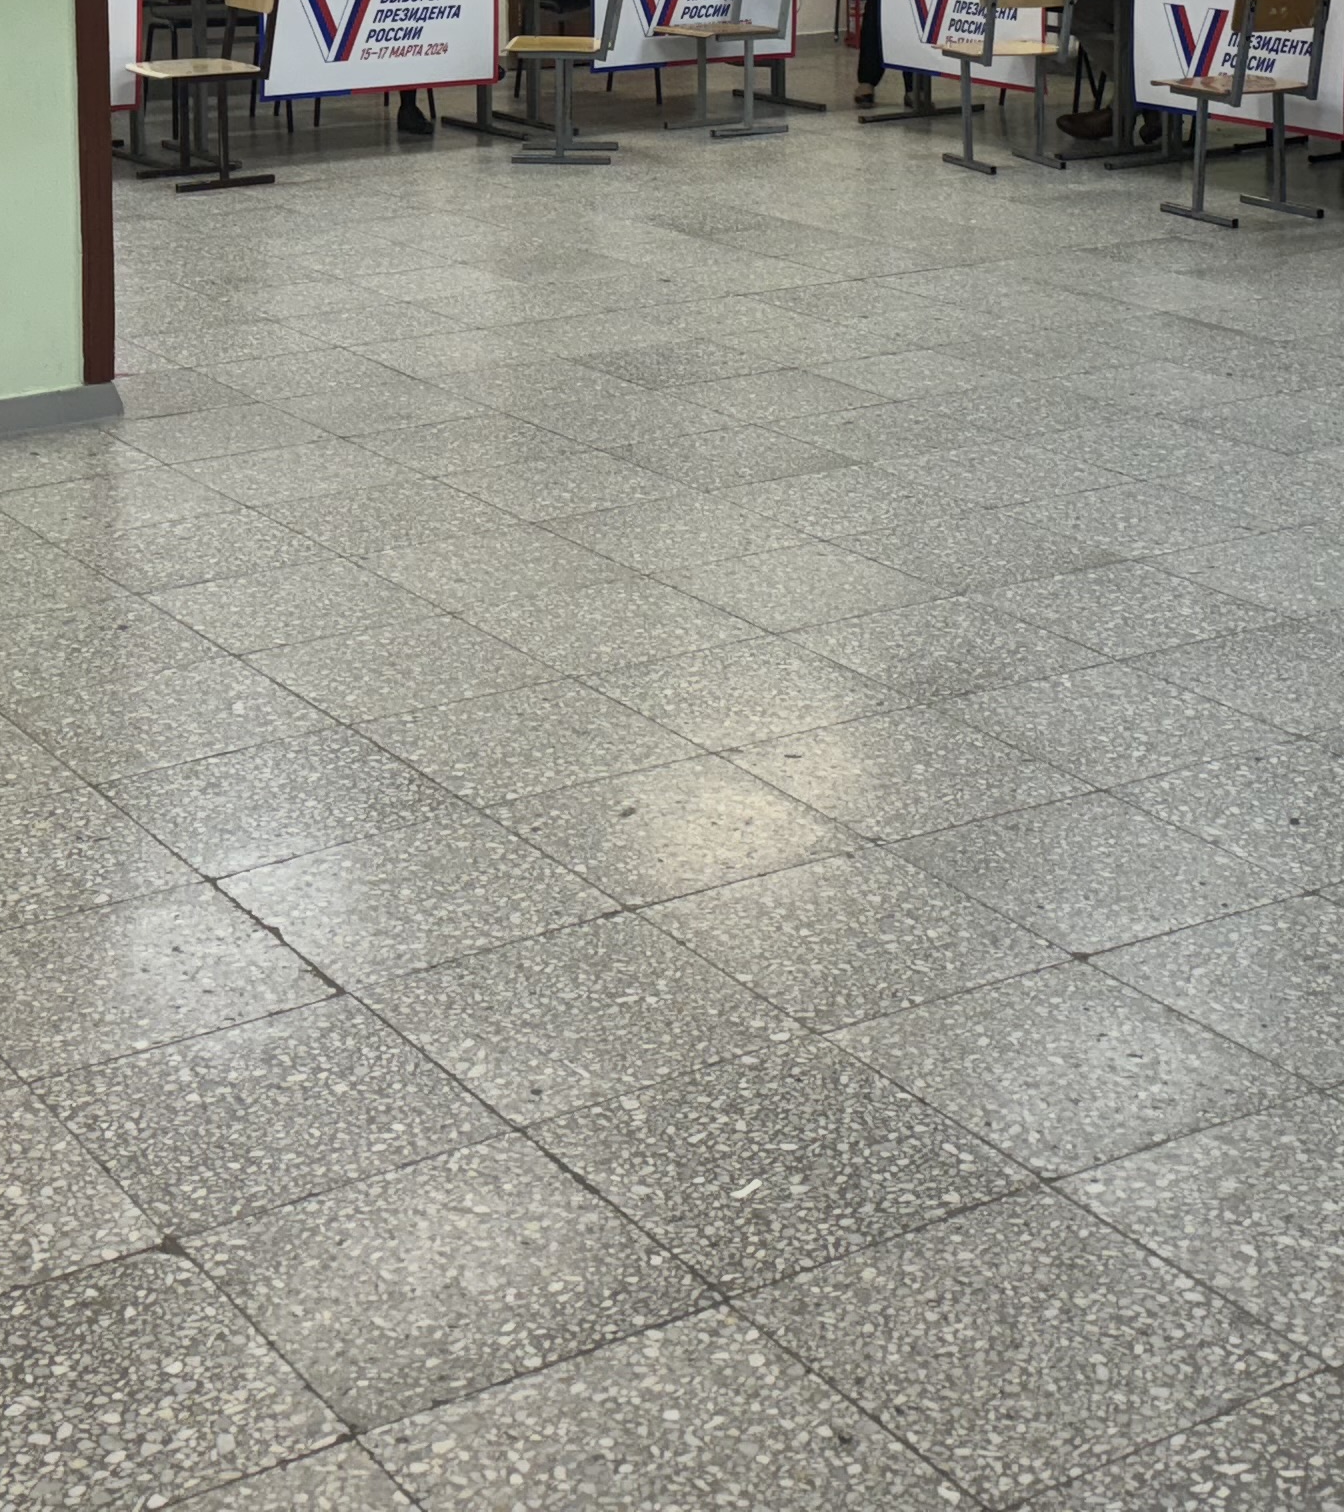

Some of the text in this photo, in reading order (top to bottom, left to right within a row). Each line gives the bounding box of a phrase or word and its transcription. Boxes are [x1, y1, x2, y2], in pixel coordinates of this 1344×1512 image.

[373, 5, 461, 24] ПРЕЗИДЕНТА
[681, 4, 731, 19] РОССИИ
[953, 0, 1018, 21] ПРЕЗИЕНТА
[365, 26, 423, 43] РОССИИ
[389, 44, 423, 59] МАРТА
[424, 42, 449, 56] 2024
[1221, 52, 1276, 73] РОСИИ
